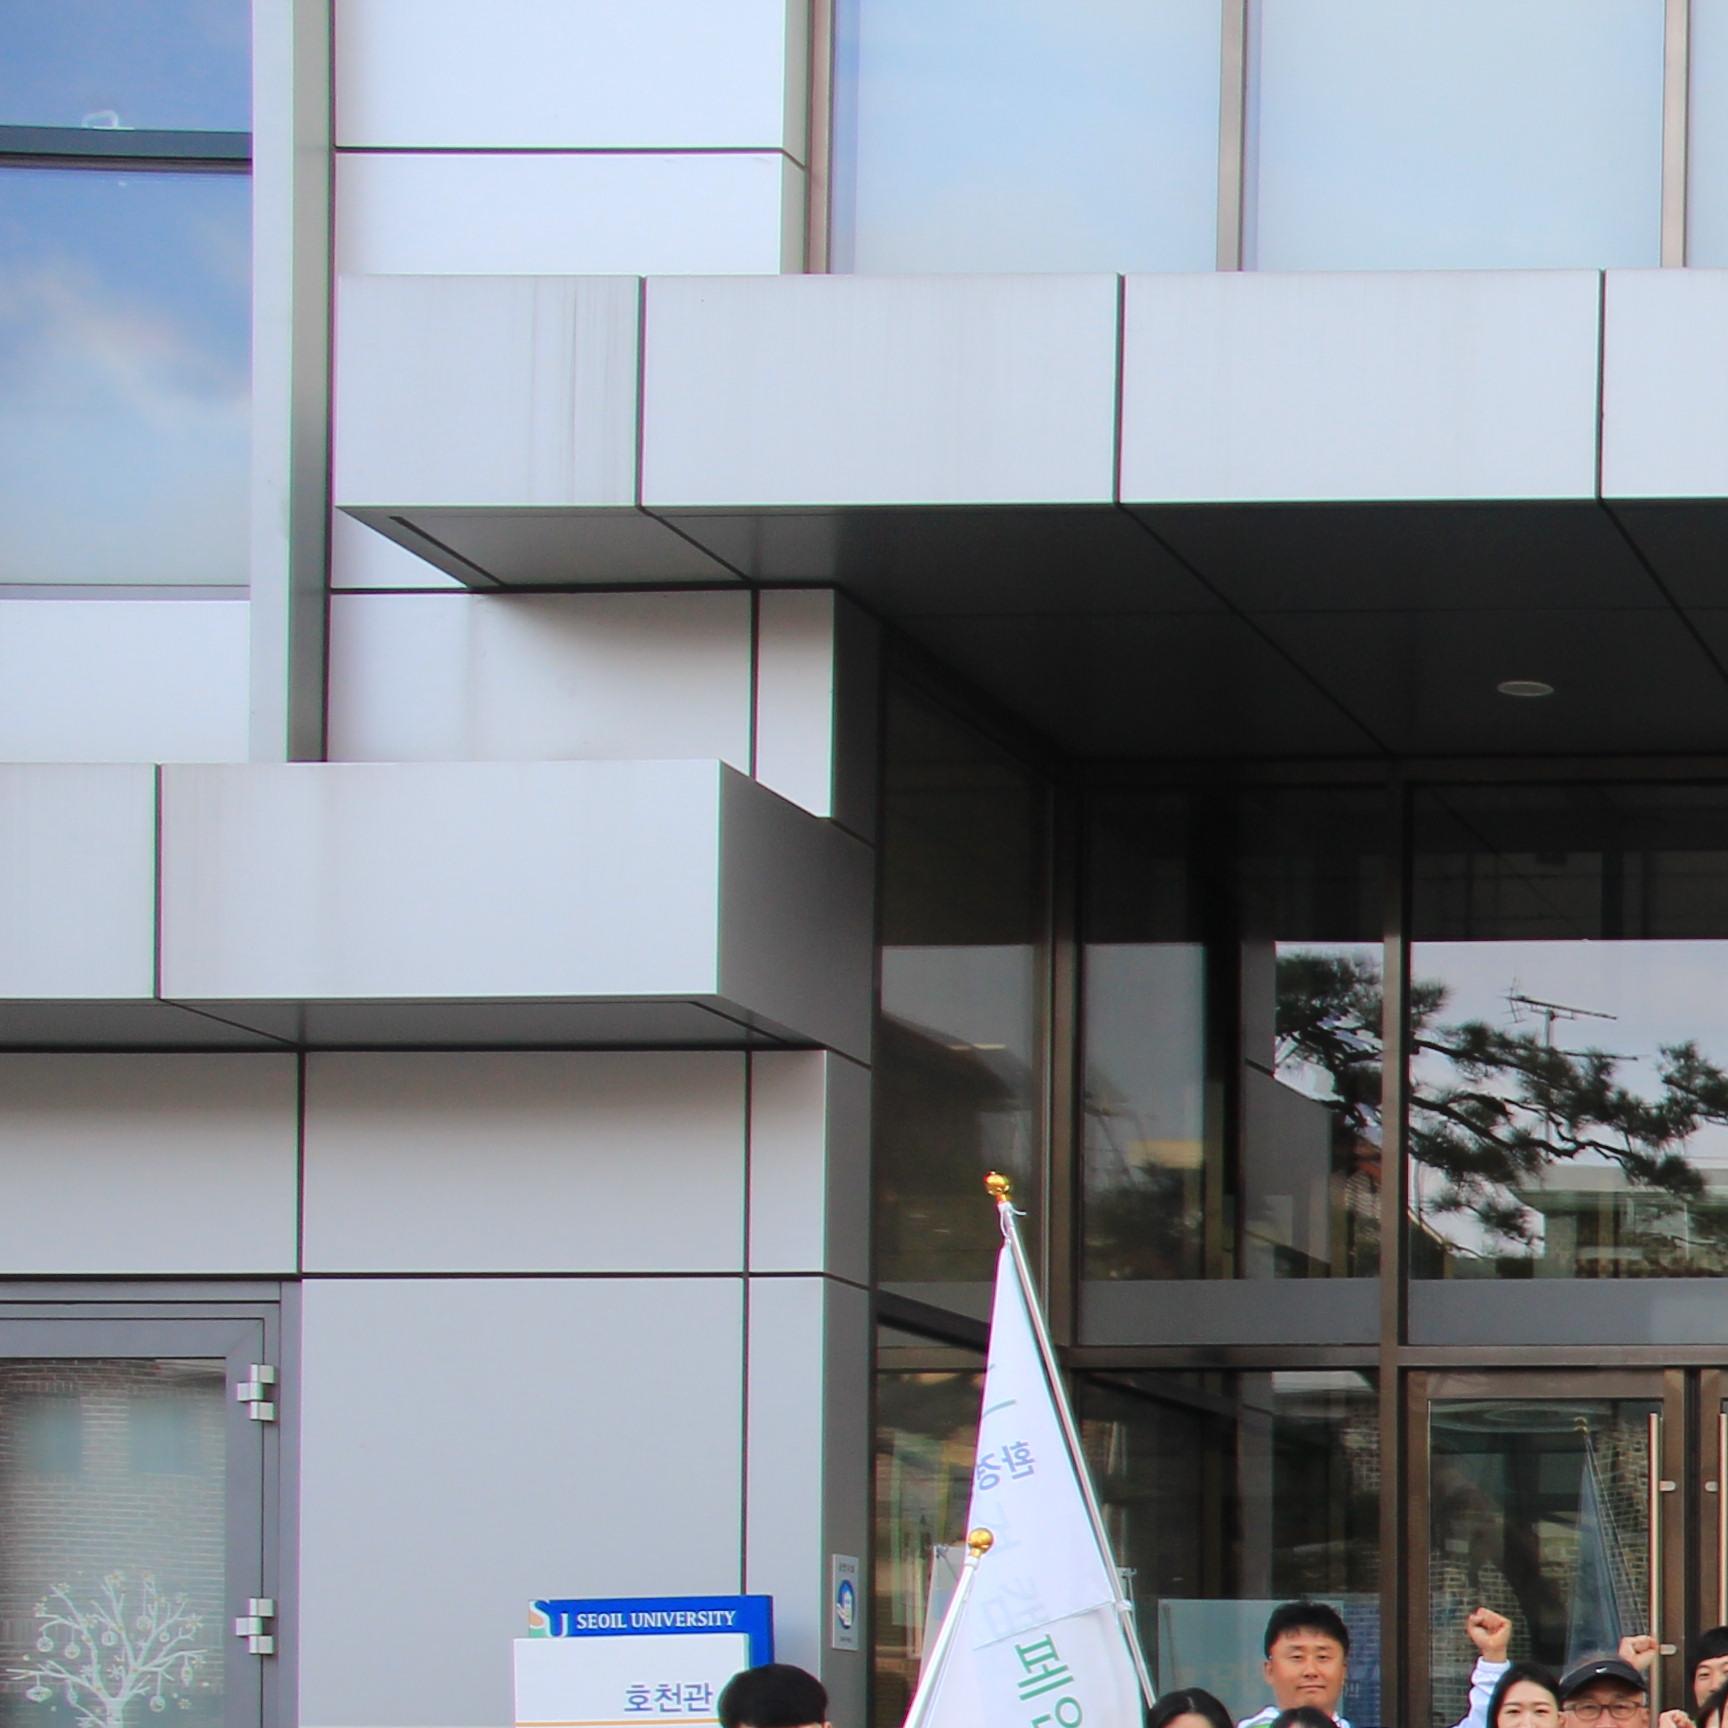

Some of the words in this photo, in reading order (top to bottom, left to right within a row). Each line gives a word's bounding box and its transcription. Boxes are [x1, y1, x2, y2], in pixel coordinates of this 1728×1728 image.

[576, 1612, 627, 1630] SEOIL
[630, 1610, 736, 1629] UNIVERSITY
[624, 1682, 714, 1713] 호천관
